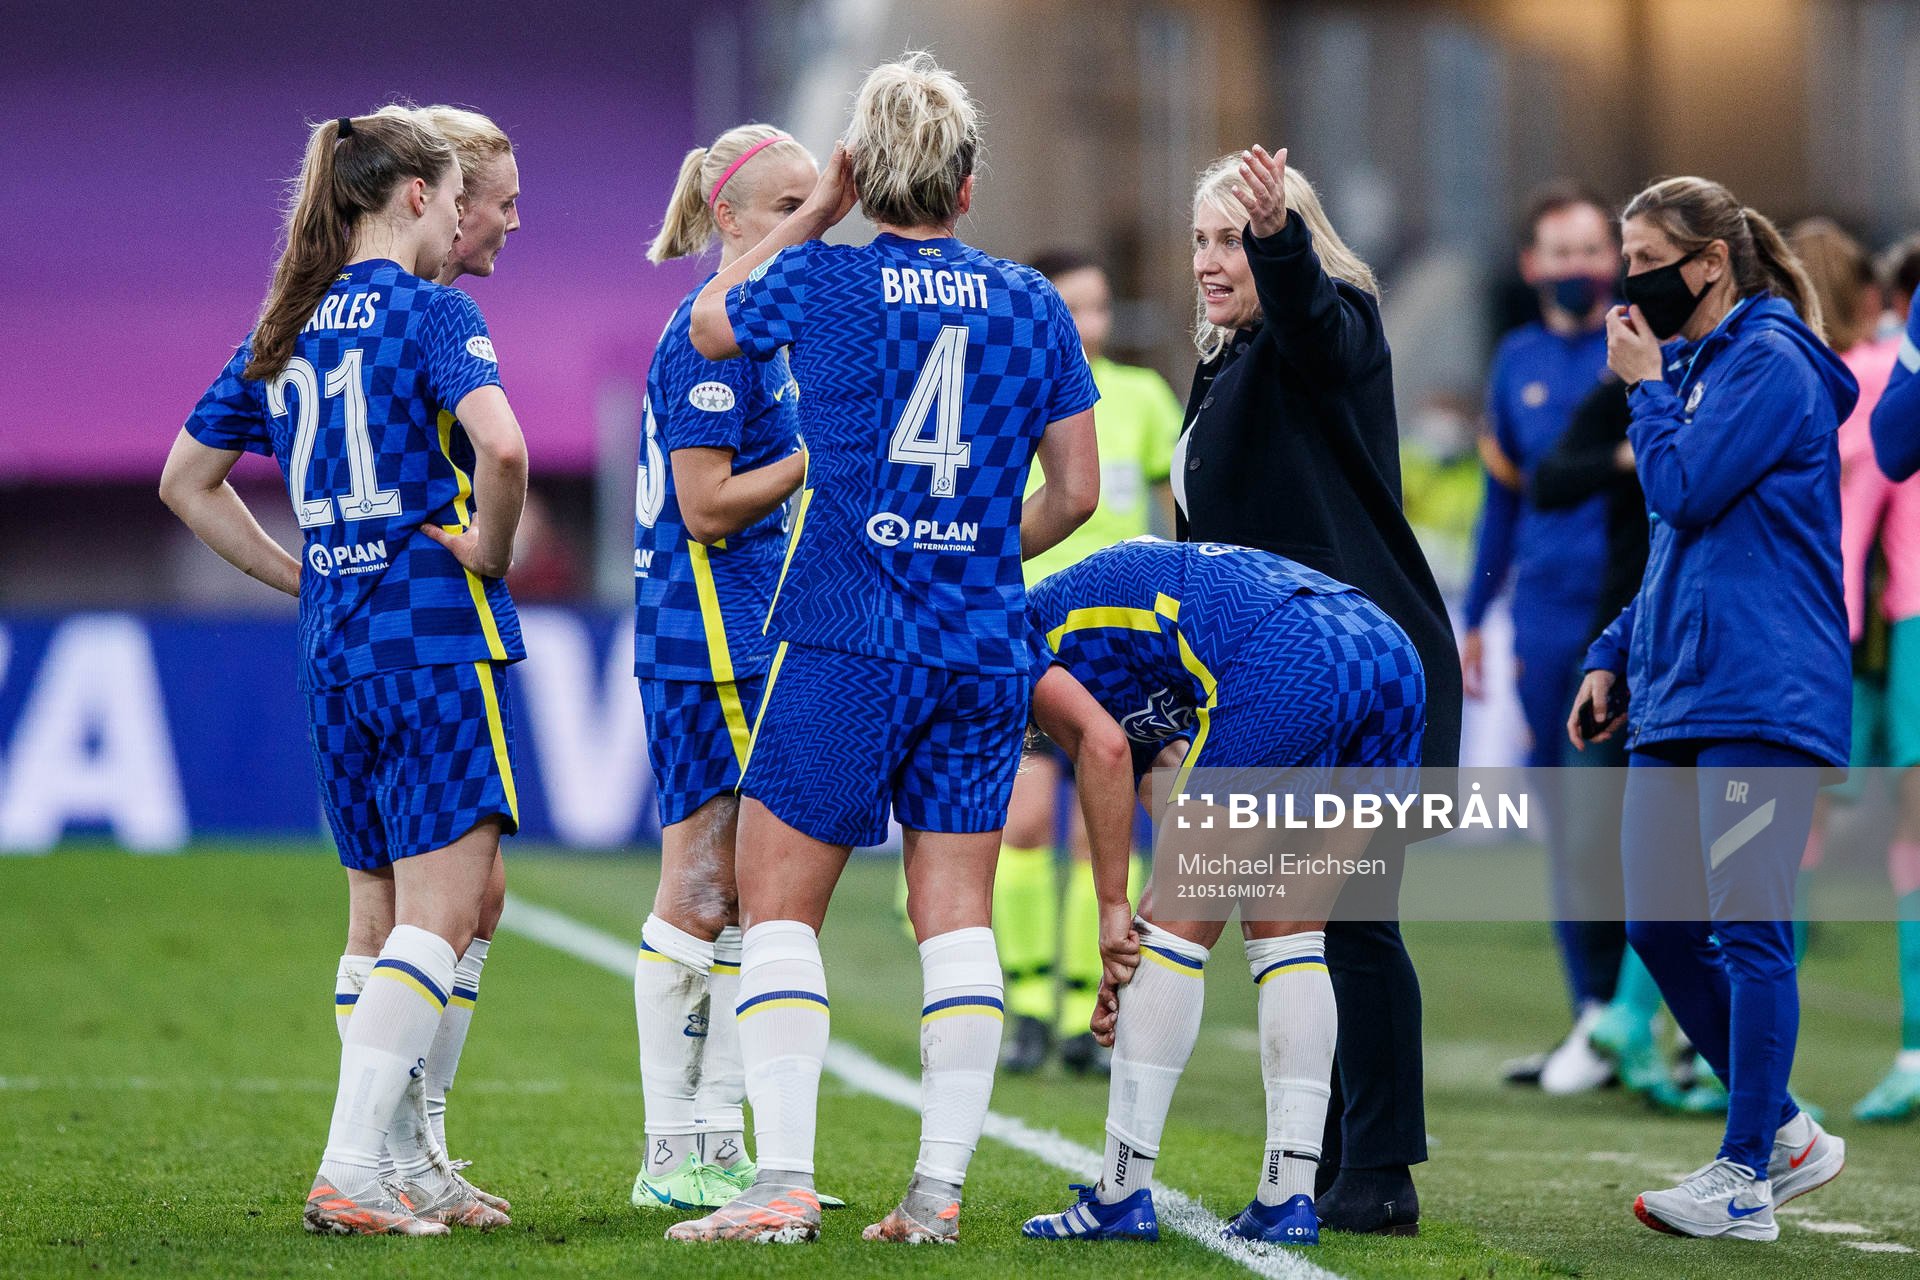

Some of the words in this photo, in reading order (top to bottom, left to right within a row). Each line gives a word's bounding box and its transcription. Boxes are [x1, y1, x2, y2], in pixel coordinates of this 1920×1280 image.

[918, 247, 942, 257] CFC
[336, 272, 353, 281] FC
[881, 267, 988, 309] BRIGHT
[300, 291, 381, 334] ARLES
[888, 325, 972, 499] 4
[265, 348, 403, 529] 21
[914, 519, 979, 542] PLAN
[333, 539, 388, 566] PLAN
[913, 542, 976, 552] INTERNATIONAL
[338, 561, 390, 576] INTERNATIONAL
[1725, 780, 1749, 804] DR
